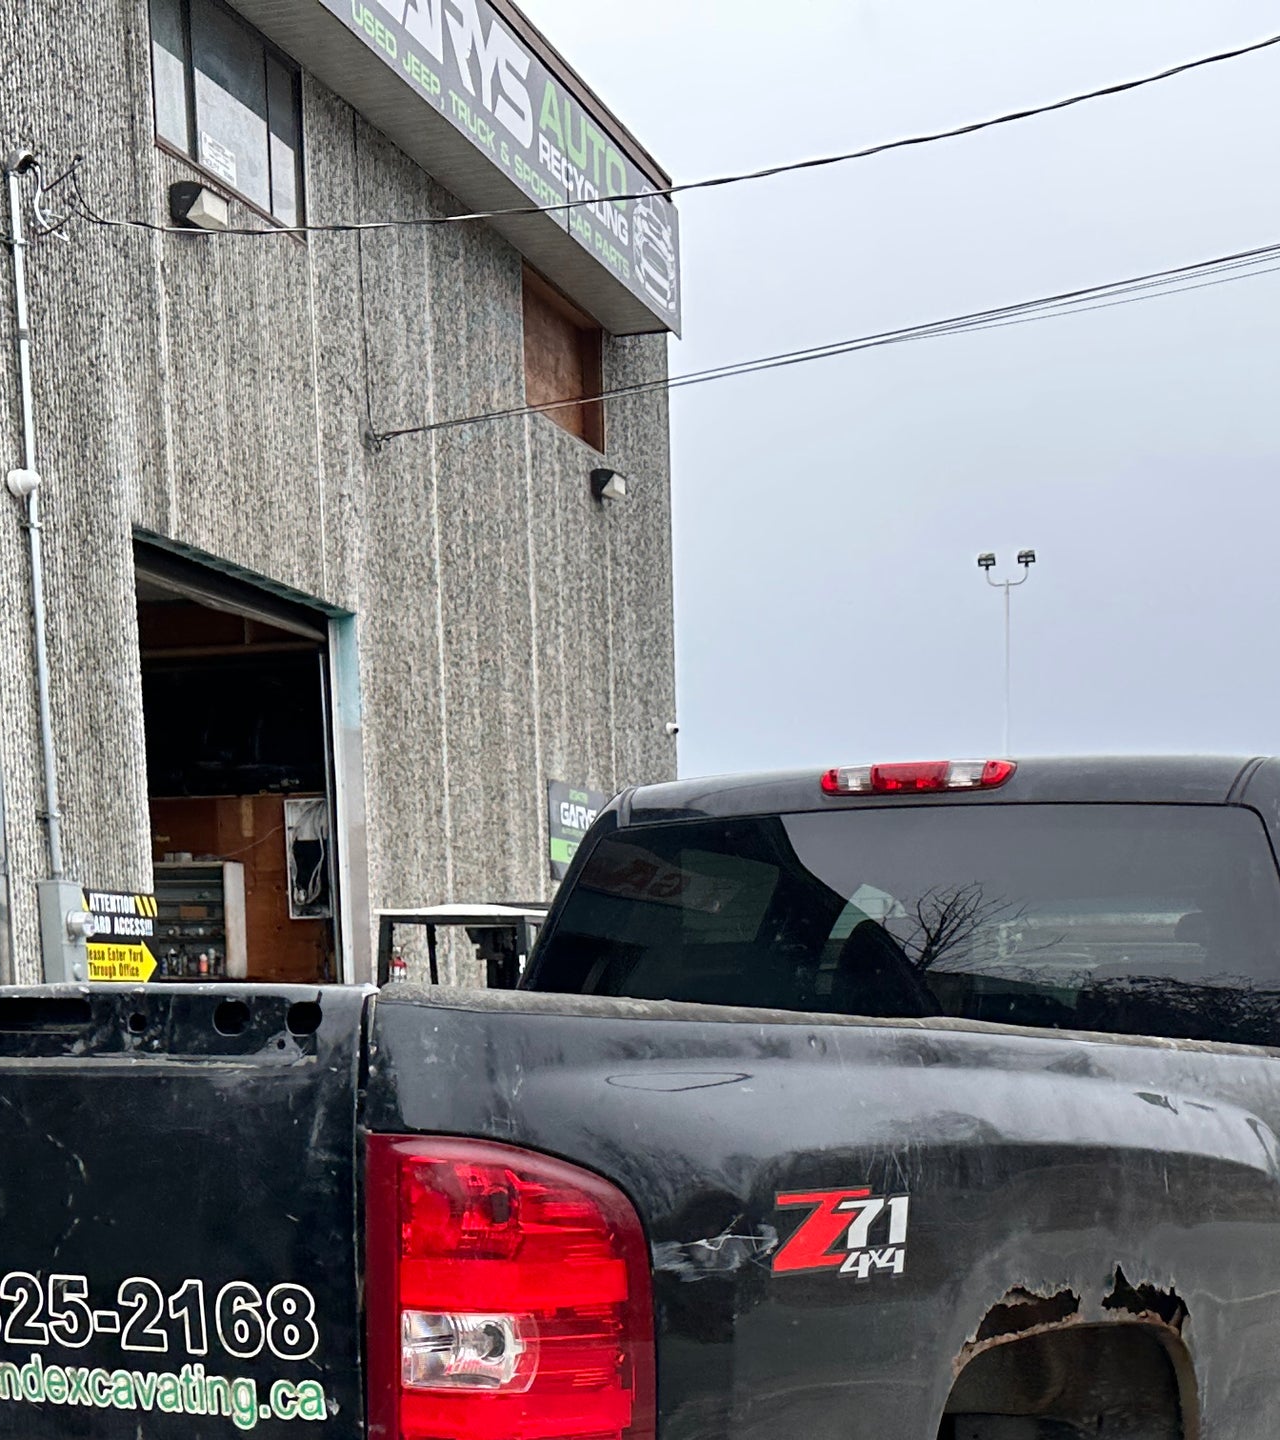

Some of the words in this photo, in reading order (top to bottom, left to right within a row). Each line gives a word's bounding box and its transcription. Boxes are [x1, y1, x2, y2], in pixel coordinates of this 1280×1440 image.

[376, 0, 533, 148] ARYS
[539, 79, 627, 211] AUTO
[351, 0, 397, 59] USED
[448, 90, 495, 153] TRUCK
[500, 141, 510, 166] &
[514, 154, 564, 217] SPORTS
[570, 206, 592, 244] CAR
[595, 233, 630, 279] PARTS
[538, 132, 628, 246] RECYCLING
[89, 892, 136, 914] ATTENTION
[93, 914, 112, 934] ARD
[114, 916, 154, 936] ACCESS!!!
[88, 962, 117, 979] Through
[119, 963, 139, 977] Office
[107, 947, 126, 962] Enter
[128, 948, 144, 962] Yard
[773, 1187, 910, 1272] Z71
